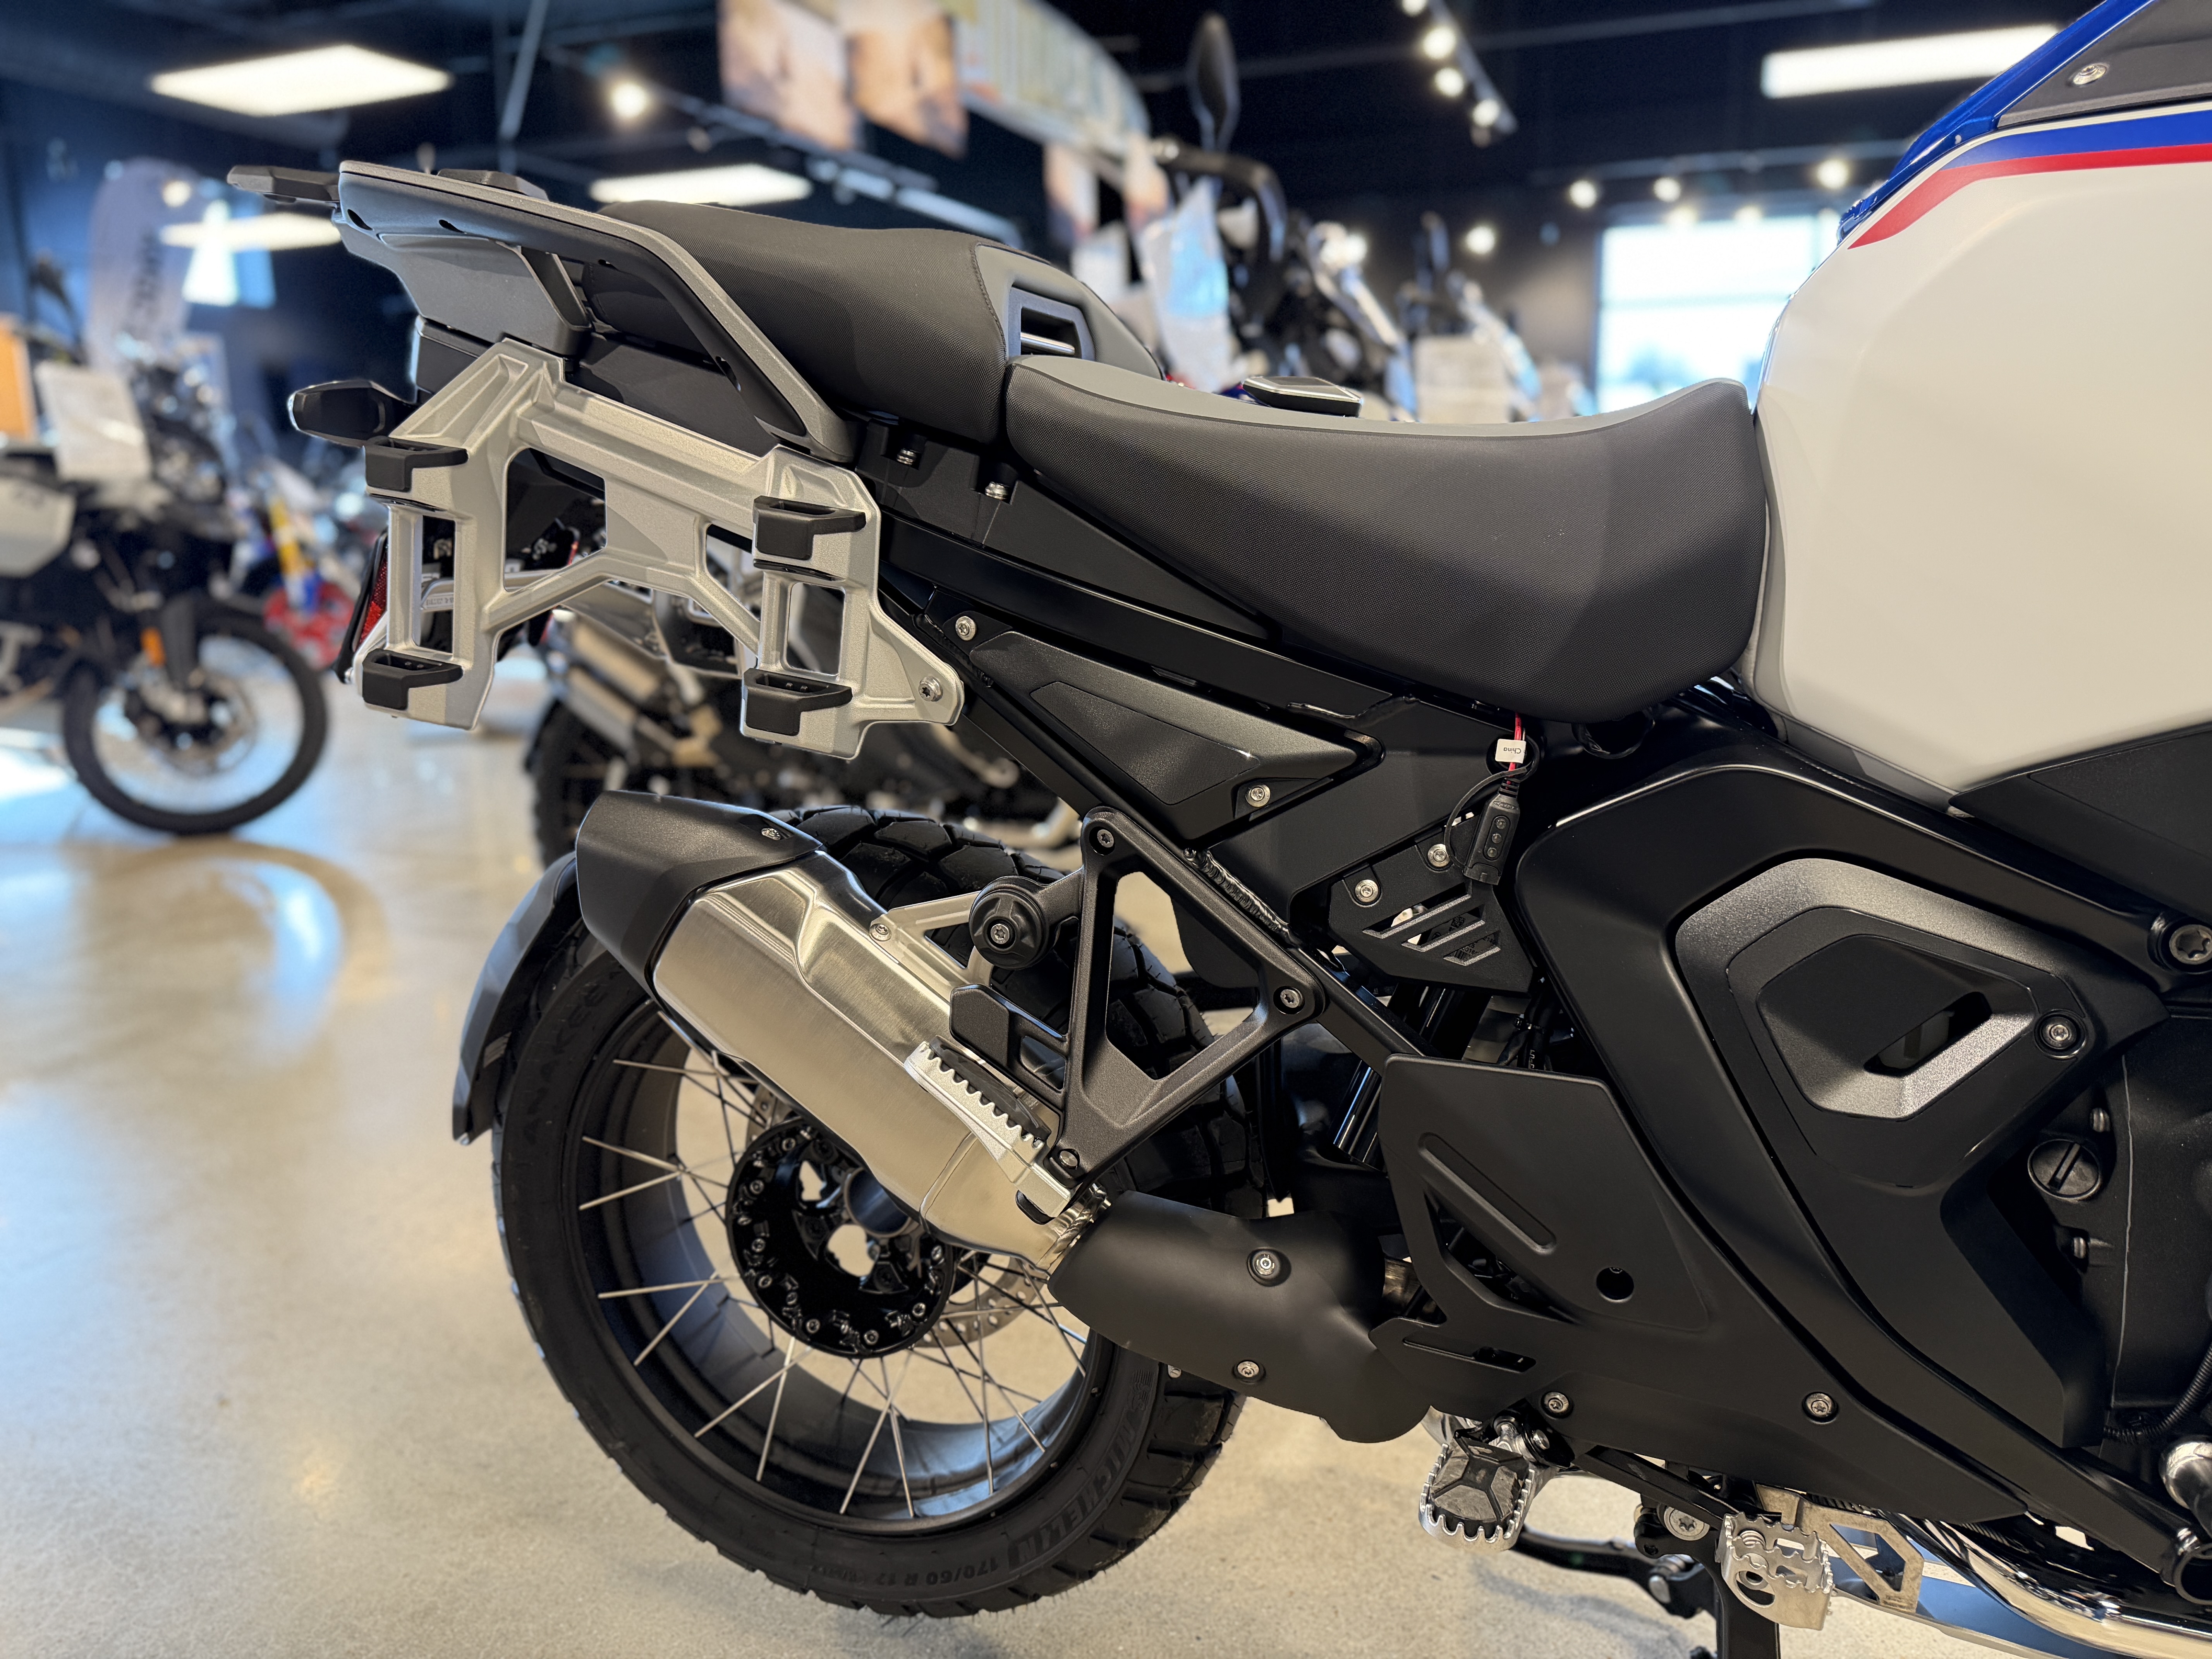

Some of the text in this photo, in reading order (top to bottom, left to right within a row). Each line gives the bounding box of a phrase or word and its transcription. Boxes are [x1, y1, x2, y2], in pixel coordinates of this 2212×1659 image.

[1017, 1415, 1137, 1565] MICHELIN
[874, 1572, 896, 1586] 17
[904, 1573, 918, 1586] R
[926, 1557, 998, 1585] 170/60
